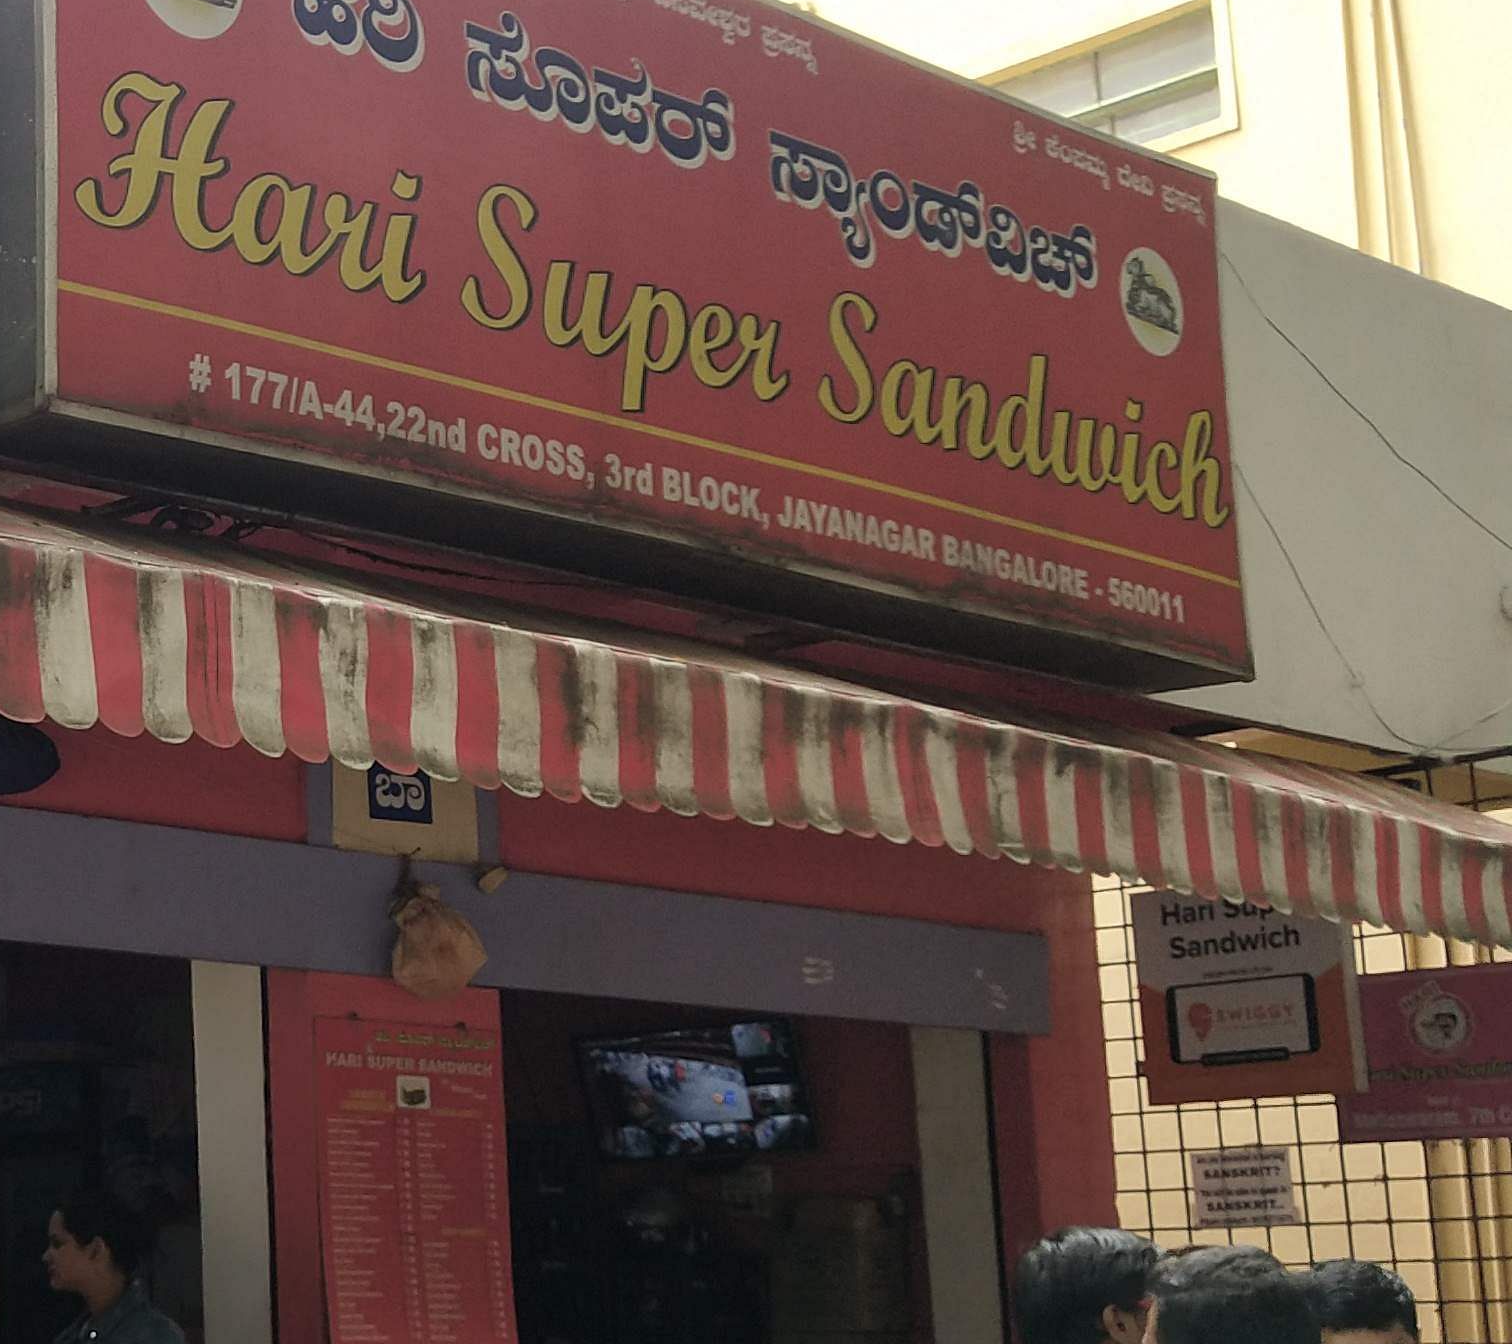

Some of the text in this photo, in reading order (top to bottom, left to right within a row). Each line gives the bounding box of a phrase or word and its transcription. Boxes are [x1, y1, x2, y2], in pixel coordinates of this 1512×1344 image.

[73, 70, 1230, 529] Hari Super Sandwich
[477, 422, 596, 490] CROSS,
[605, 453, 654, 497] 3rd
[662, 467, 770, 531] BLOCK,
[776, 494, 936, 561] JAYANAGAR
[941, 533, 1089, 600] BANGALORE
[1107, 576, 1185, 624] 560011
[1160, 899, 1274, 926] Hari Sup
[1169, 923, 1301, 960] Sandwich
[1215, 1002, 1295, 1023] SWIGGY
[368, 1053, 416, 1071] SUPER
[418, 1057, 493, 1078] SANDWICH
